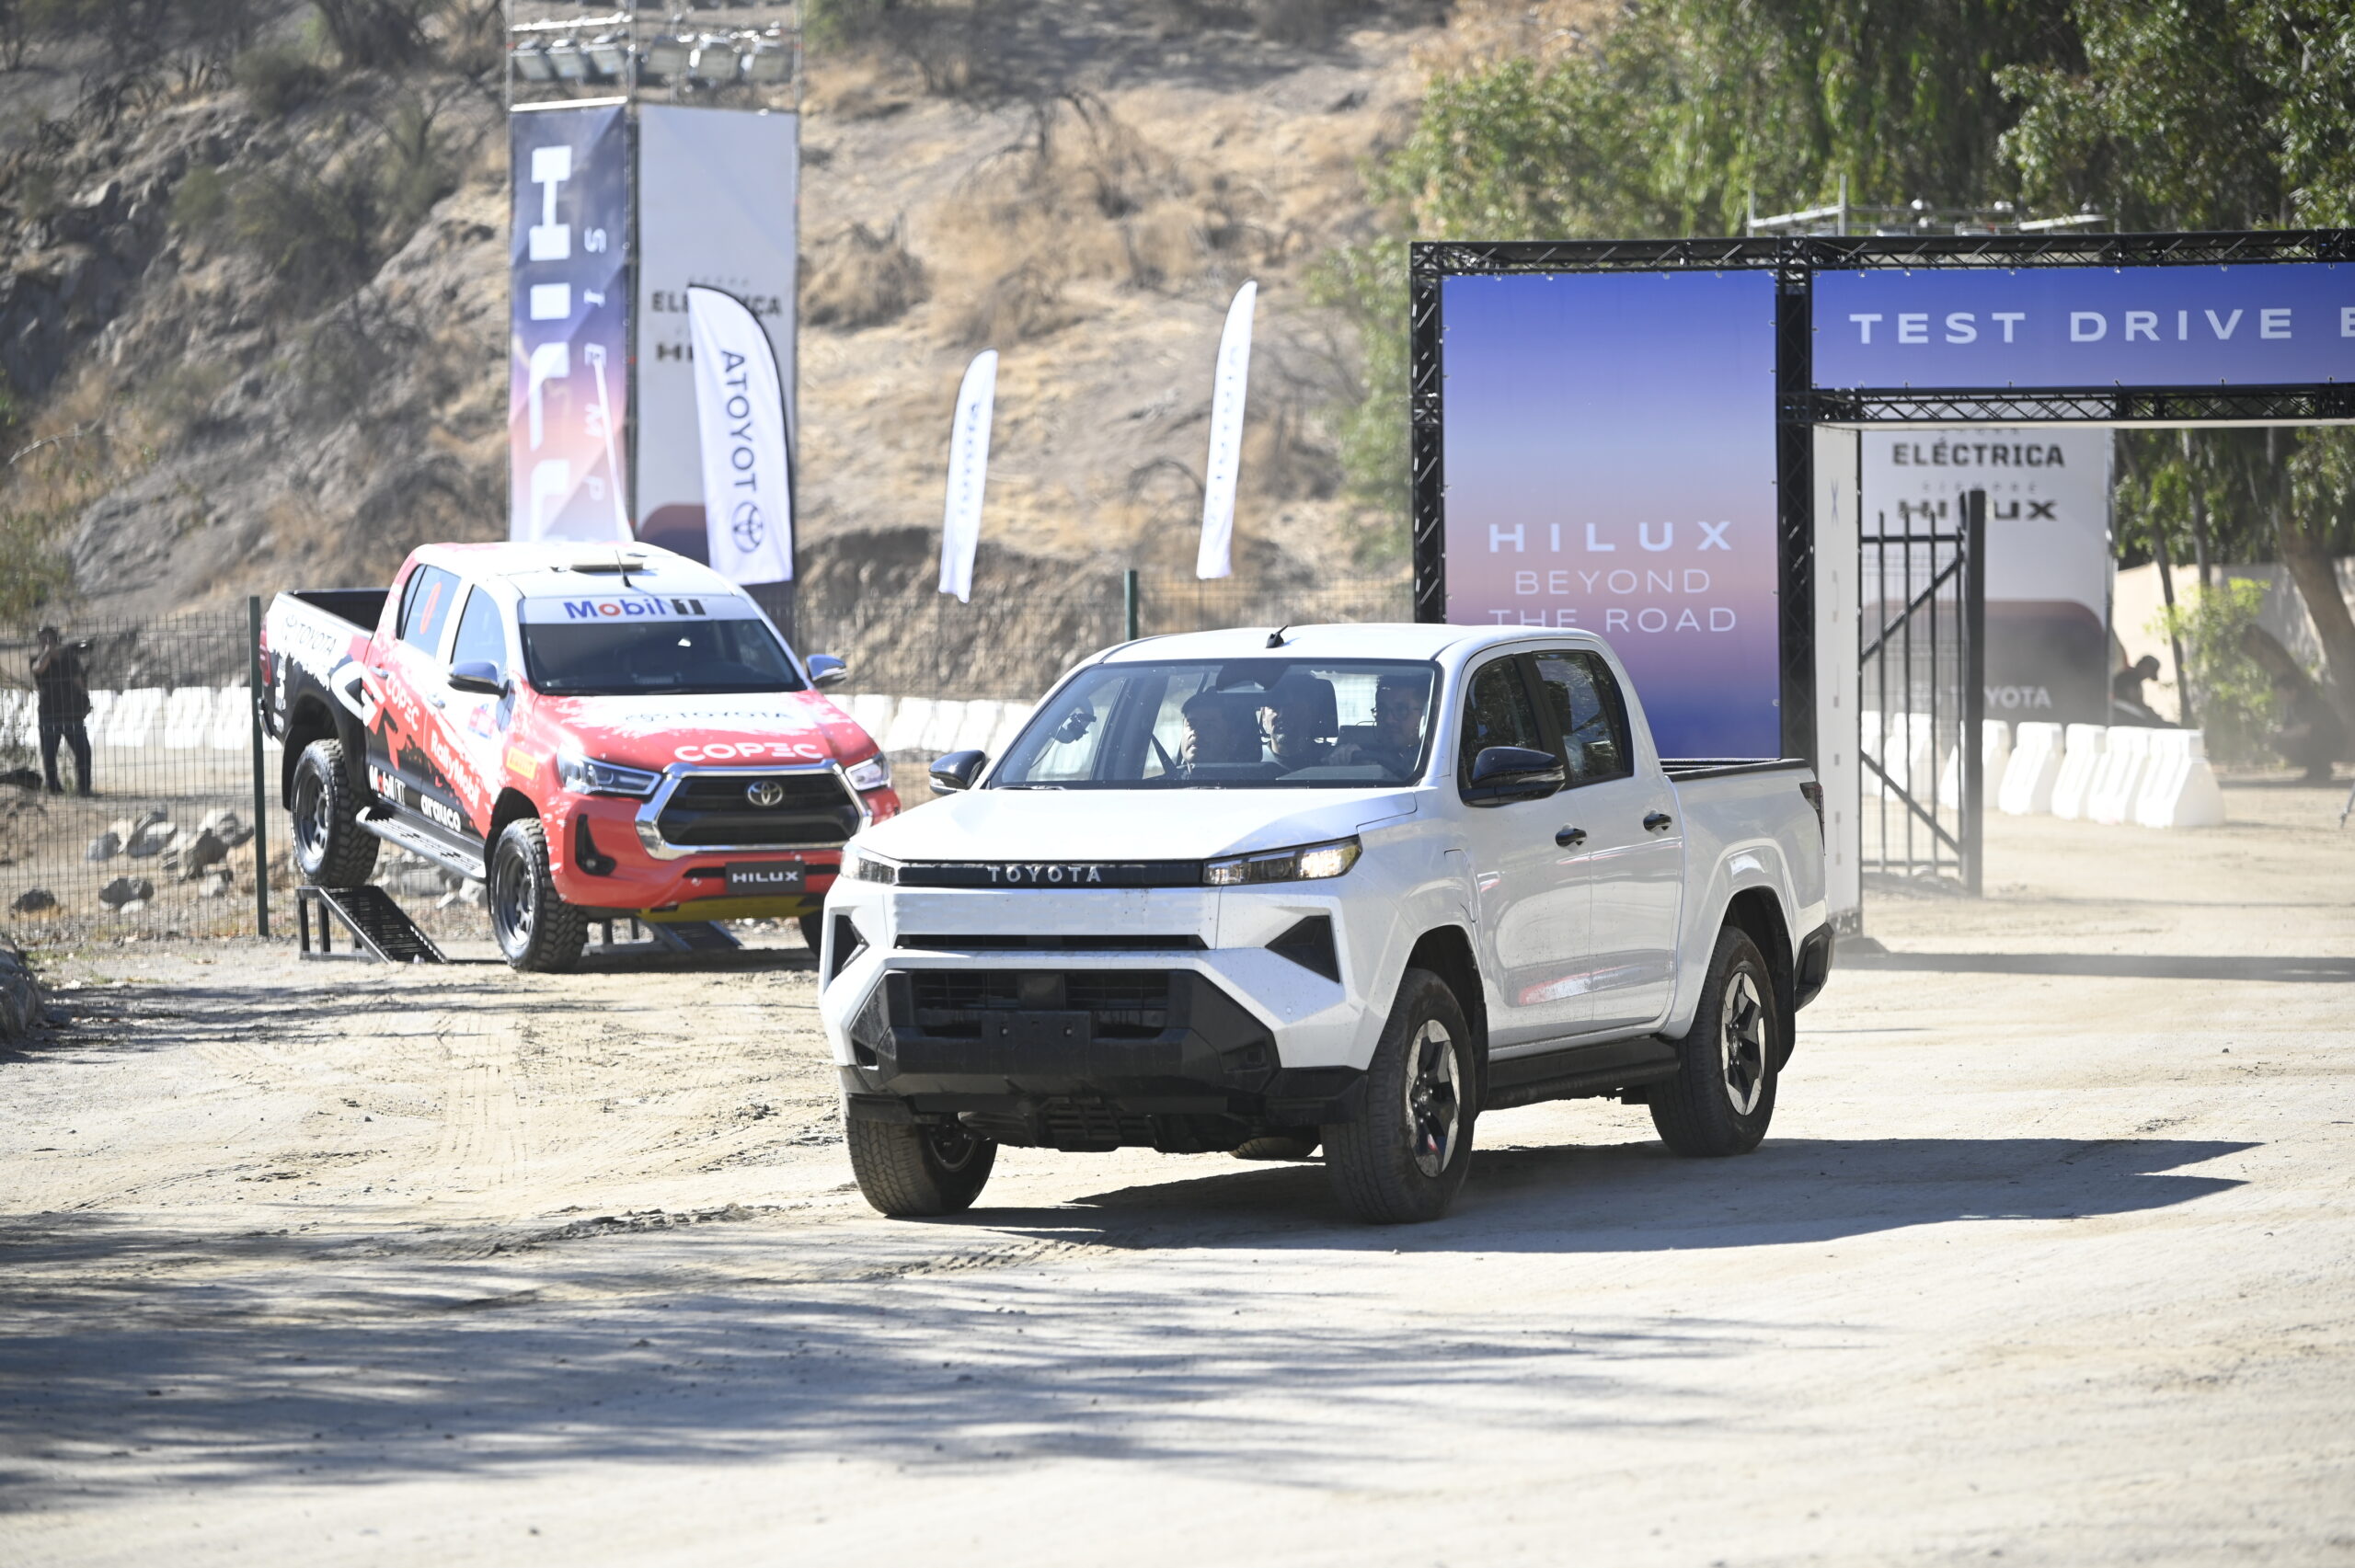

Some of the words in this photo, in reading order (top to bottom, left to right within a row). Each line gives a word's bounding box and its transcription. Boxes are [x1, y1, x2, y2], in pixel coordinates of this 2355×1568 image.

[1849, 311, 2026, 345] TEST
[2070, 308, 2292, 343] DRIVE
[529, 144, 571, 541] HILU
[583, 226, 607, 542] SIEMP
[1891, 437, 2065, 467] ELÉCTRICA
[1898, 499, 2057, 521] HIUX
[1488, 521, 1732, 553] HILUX
[1514, 568, 1711, 595] BEYOND
[563, 598, 666, 619] Mobil
[670, 599, 706, 616] 1
[1488, 609, 1578, 627] THE
[1605, 607, 1737, 633] ROAD
[385, 671, 419, 731] COPEC
[673, 742, 824, 762] COPEC
[369, 764, 396, 799] Mobil
[420, 794, 461, 832] arauco
[732, 871, 798, 883] HILUX
[987, 865, 1101, 883] TOYOTA
